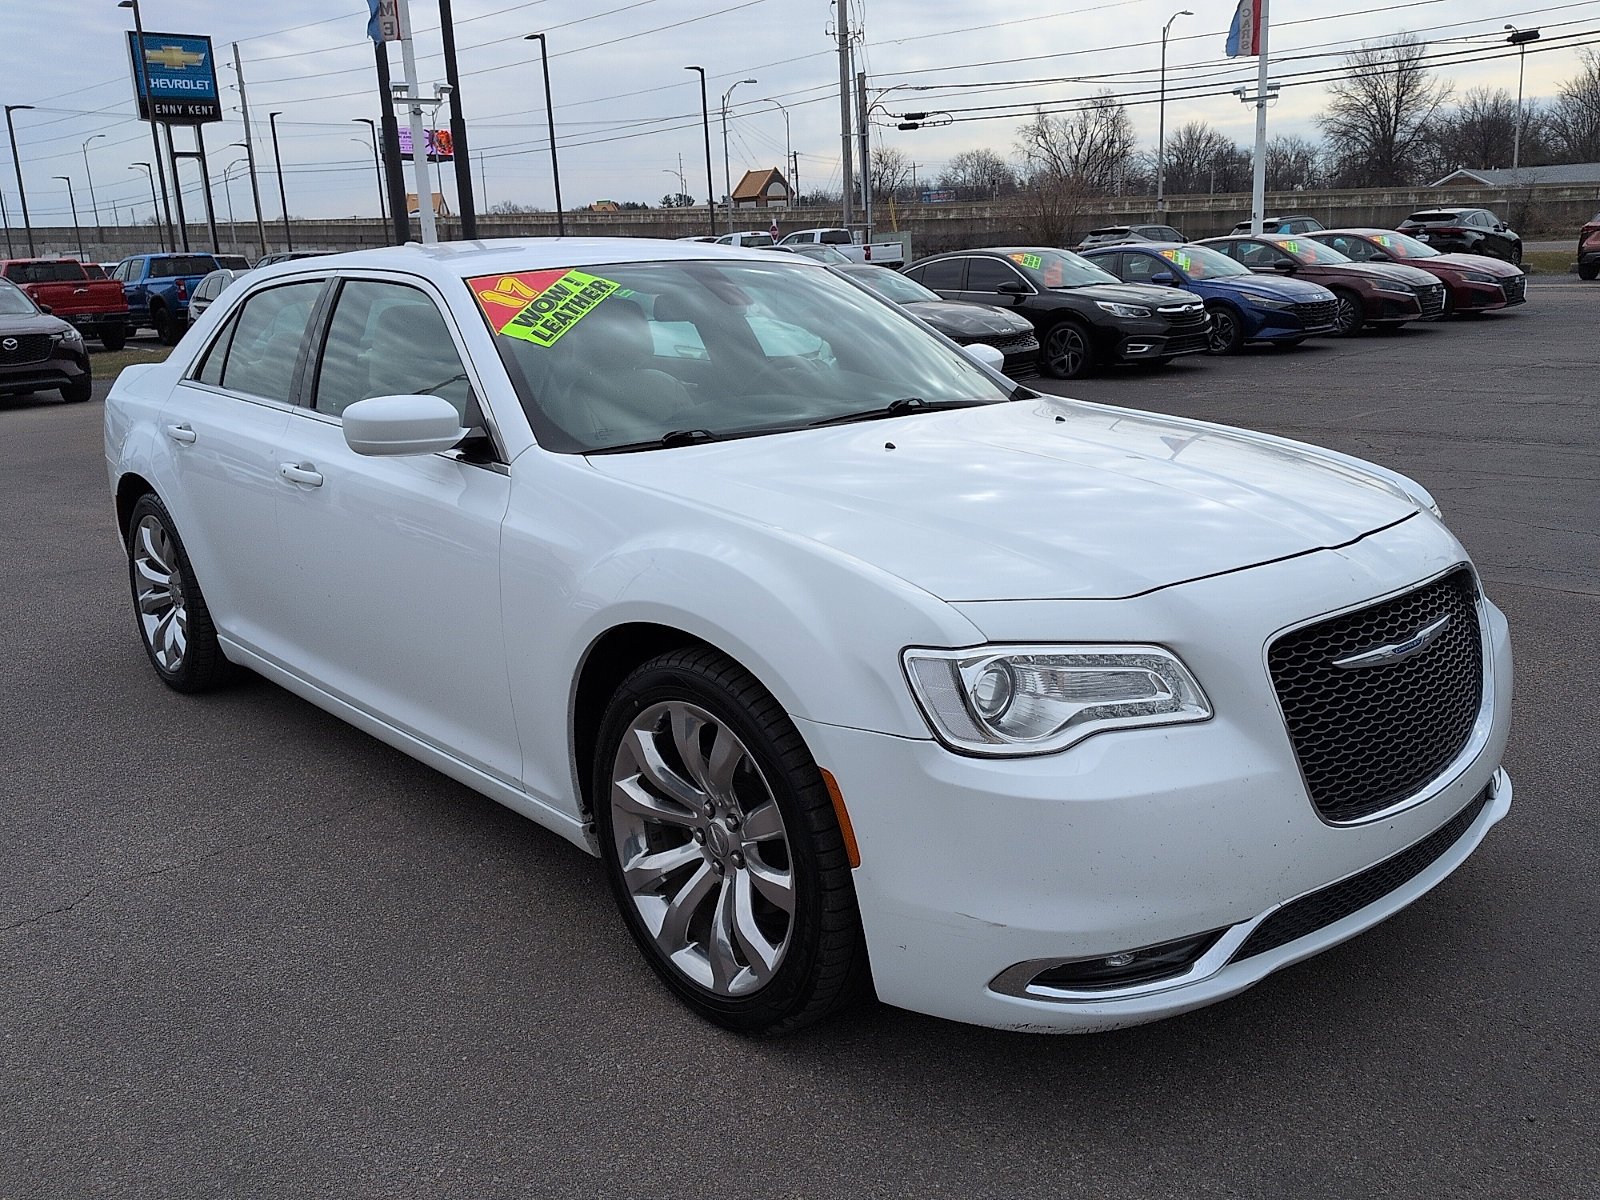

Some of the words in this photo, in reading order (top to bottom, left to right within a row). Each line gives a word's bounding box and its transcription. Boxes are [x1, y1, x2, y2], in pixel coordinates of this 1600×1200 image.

[149, 78, 210, 90] HEVROLET
[154, 104, 183, 115] ENNY
[188, 105, 214, 115] KENT
[478, 277, 540, 309] 17
[531, 280, 616, 342] LEATHER
